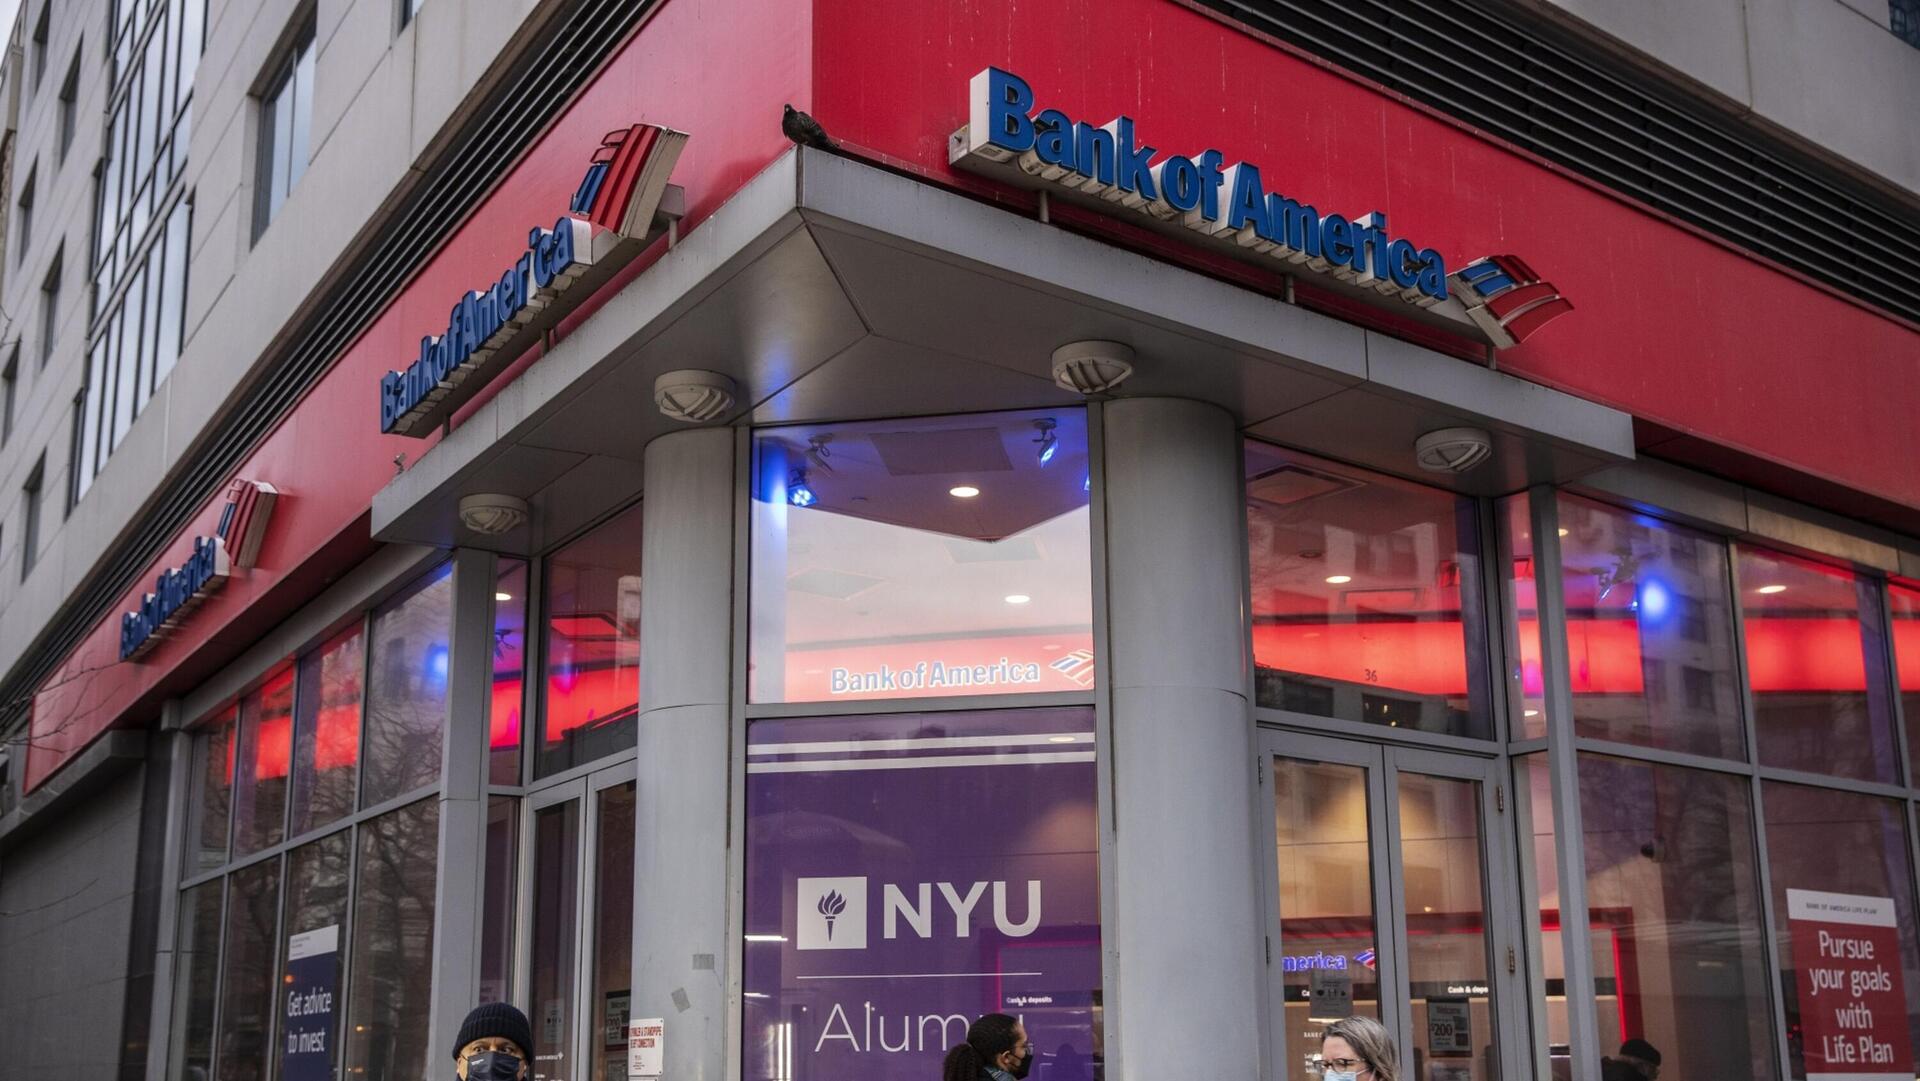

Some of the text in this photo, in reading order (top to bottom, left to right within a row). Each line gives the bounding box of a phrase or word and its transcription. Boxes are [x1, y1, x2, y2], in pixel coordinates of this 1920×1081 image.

[989, 66, 1448, 300] Bank of America
[381, 217, 575, 433] Bank of America
[831, 657, 1040, 694] Bank of America
[1364, 669, 1378, 682] 36
[883, 880, 1042, 939] NYU
[1818, 930, 1875, 960] Pursue
[1281, 952, 1348, 972] merica
[1472, 986, 1489, 995] depo
[1809, 964, 1892, 998] your goals
[287, 986, 332, 1017] Get advice
[1028, 996, 1053, 1005] deposits
[1836, 1001, 1874, 1030] with
[288, 1027, 326, 1054] to invest
[815, 1001, 1024, 1052] Alum
[1823, 1035, 1894, 1064] Life Plan
